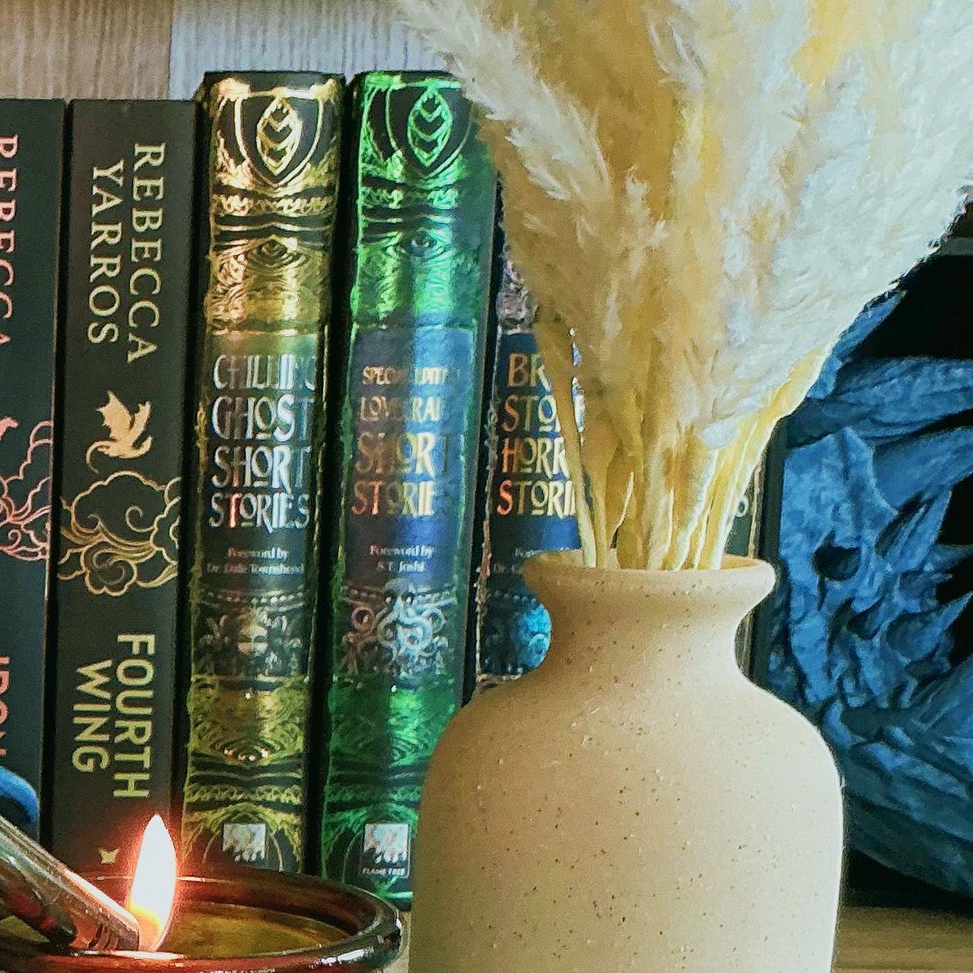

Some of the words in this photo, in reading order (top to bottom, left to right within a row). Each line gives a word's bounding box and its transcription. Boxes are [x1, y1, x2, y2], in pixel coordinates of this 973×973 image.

[87, 159, 125, 344] YARROS
[127, 143, 166, 364] REBECCA
[211, 445, 311, 494] SHORT
[212, 394, 314, 442] GHOST
[209, 493, 310, 533] STORIES
[72, 659, 113, 773] WING
[113, 633, 156, 798] FOURTH
